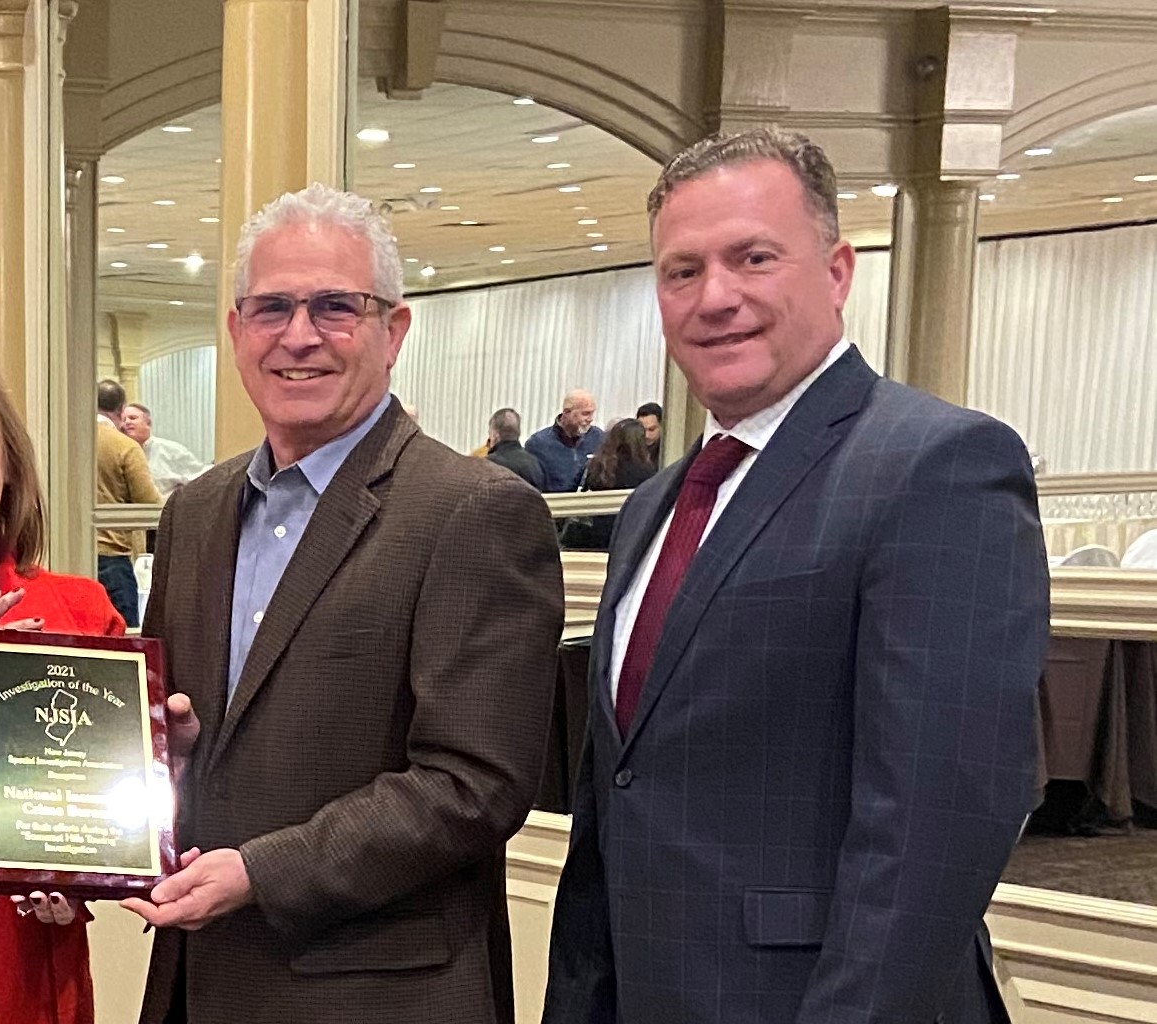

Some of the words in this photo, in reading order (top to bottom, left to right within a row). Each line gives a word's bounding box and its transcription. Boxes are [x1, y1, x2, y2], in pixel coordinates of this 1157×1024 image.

[46, 664, 76, 677] 2021
[68, 680, 81, 690] of
[82, 682, 100, 696] the
[103, 687, 126, 708] Year
[34, 707, 93, 726] NJSIA
[3, 785, 63, 802] National
